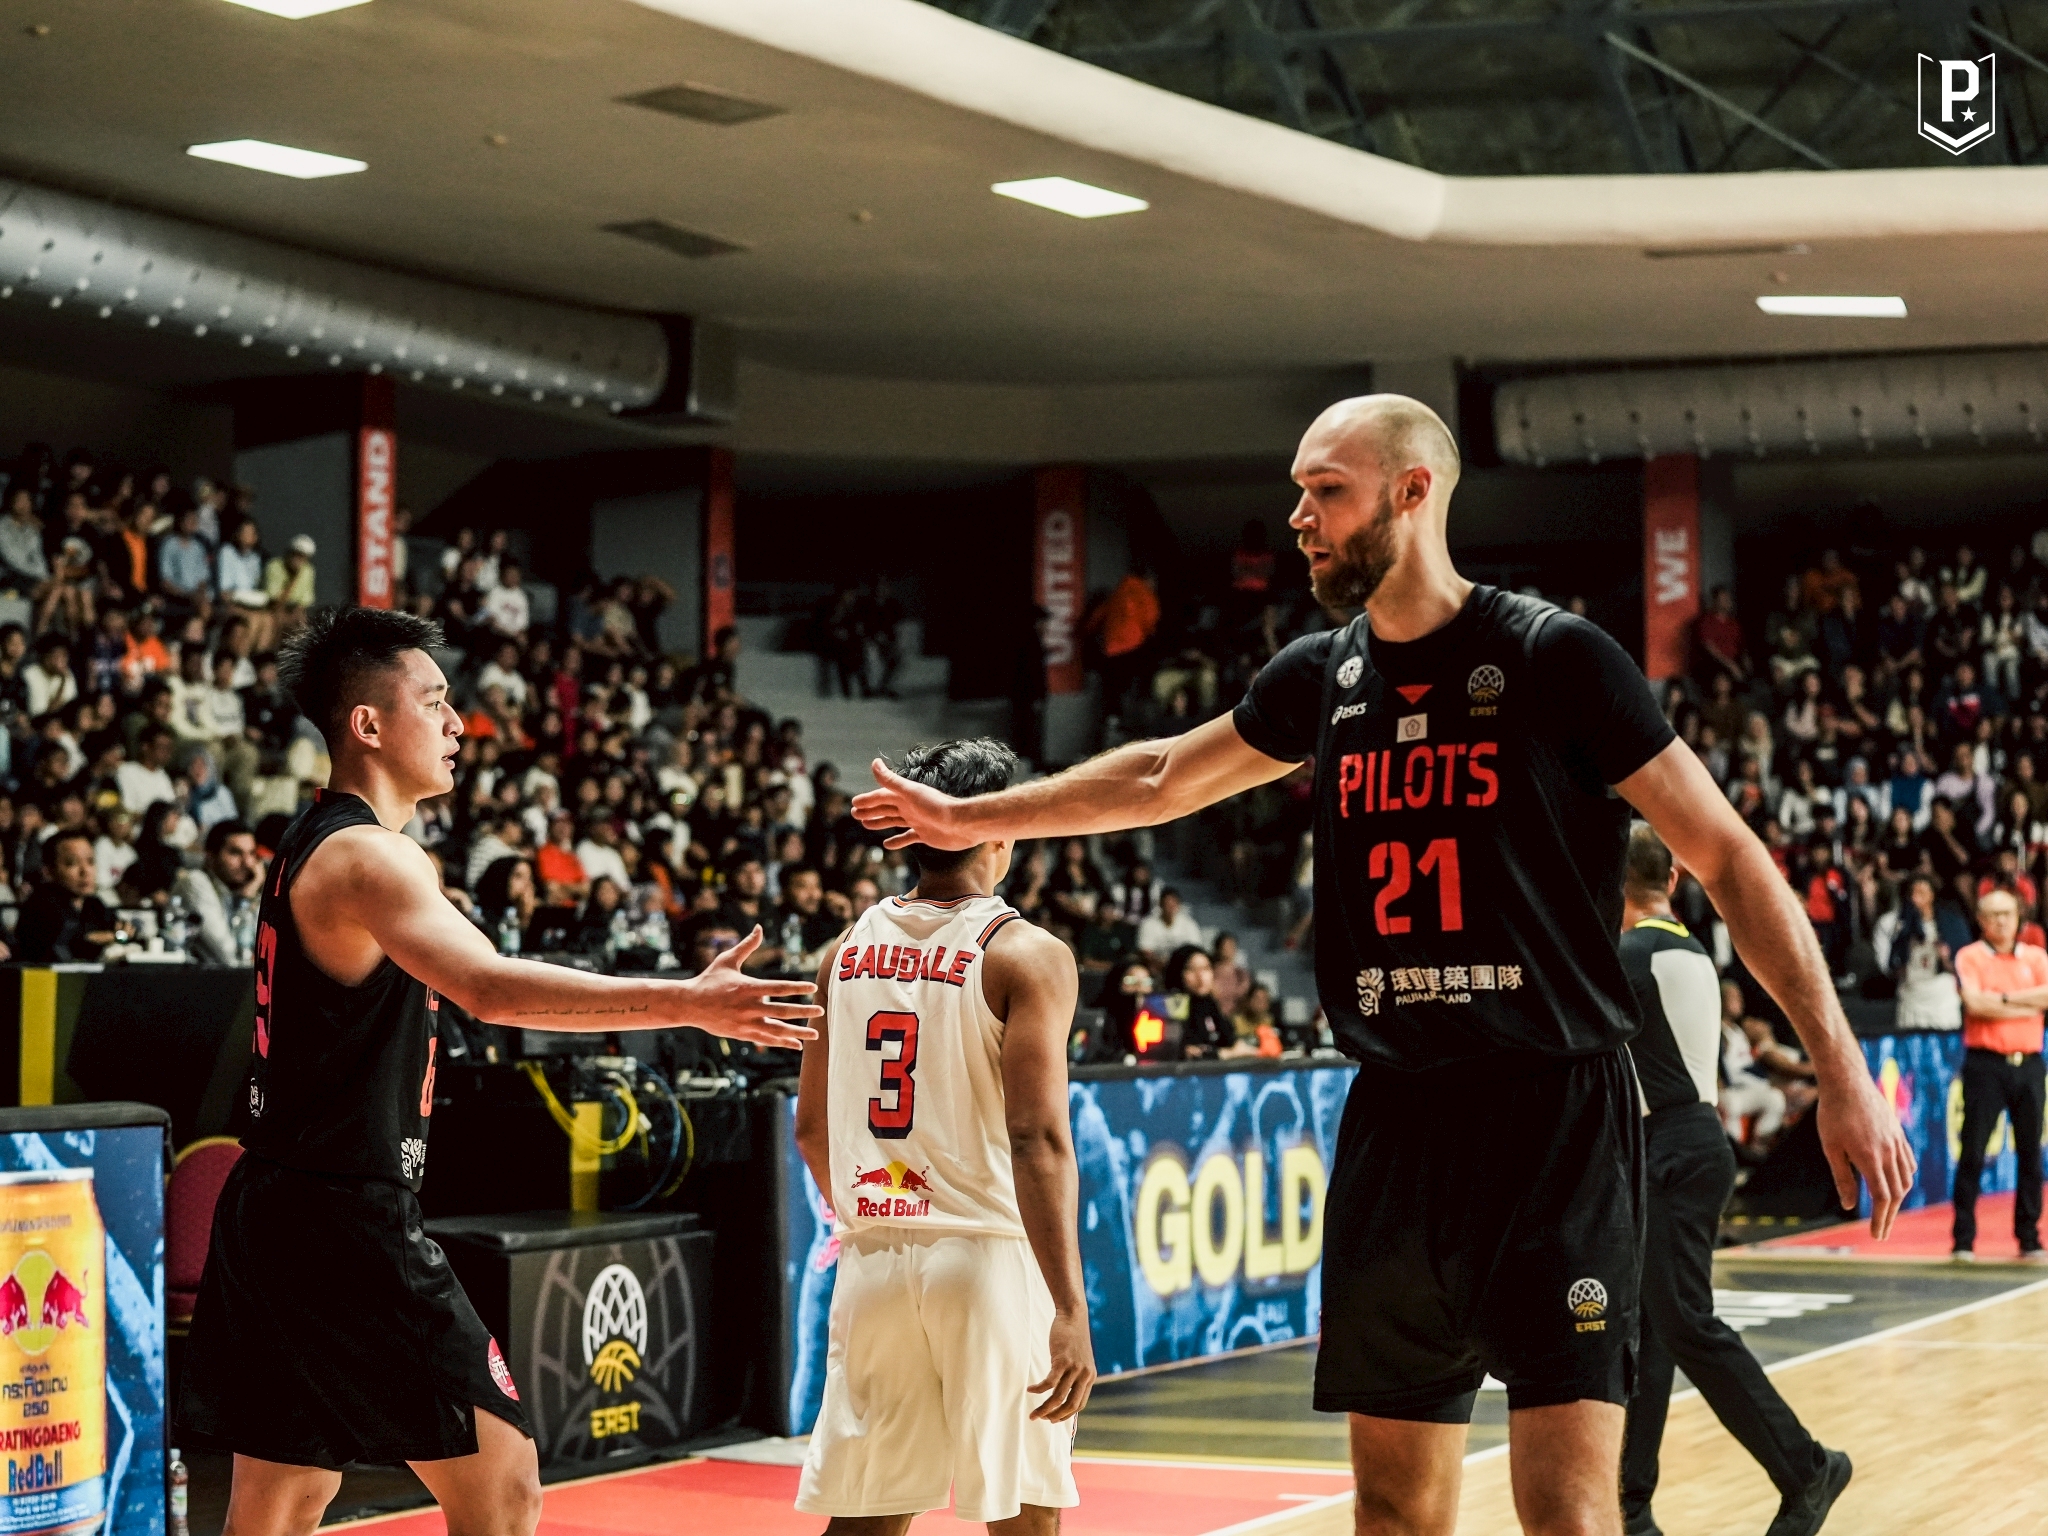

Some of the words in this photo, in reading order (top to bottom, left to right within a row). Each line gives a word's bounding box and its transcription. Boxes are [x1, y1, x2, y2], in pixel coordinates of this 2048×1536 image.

[367, 430, 390, 597] STAND
[1043, 510, 1073, 664] UNITED
[1655, 527, 1688, 604] WE
[1339, 742, 1499, 818] PILOTS
[1369, 838, 1463, 936] 21
[839, 944, 977, 988] SAUDALE
[865, 1010, 919, 1139] 3
[857, 1197, 891, 1217] Red
[894, 1197, 930, 1217] Bull
[1137, 1146, 1326, 1295] GOLD
[1575, 1320, 1606, 1333] EAST
[590, 1401, 642, 1439] EAST
